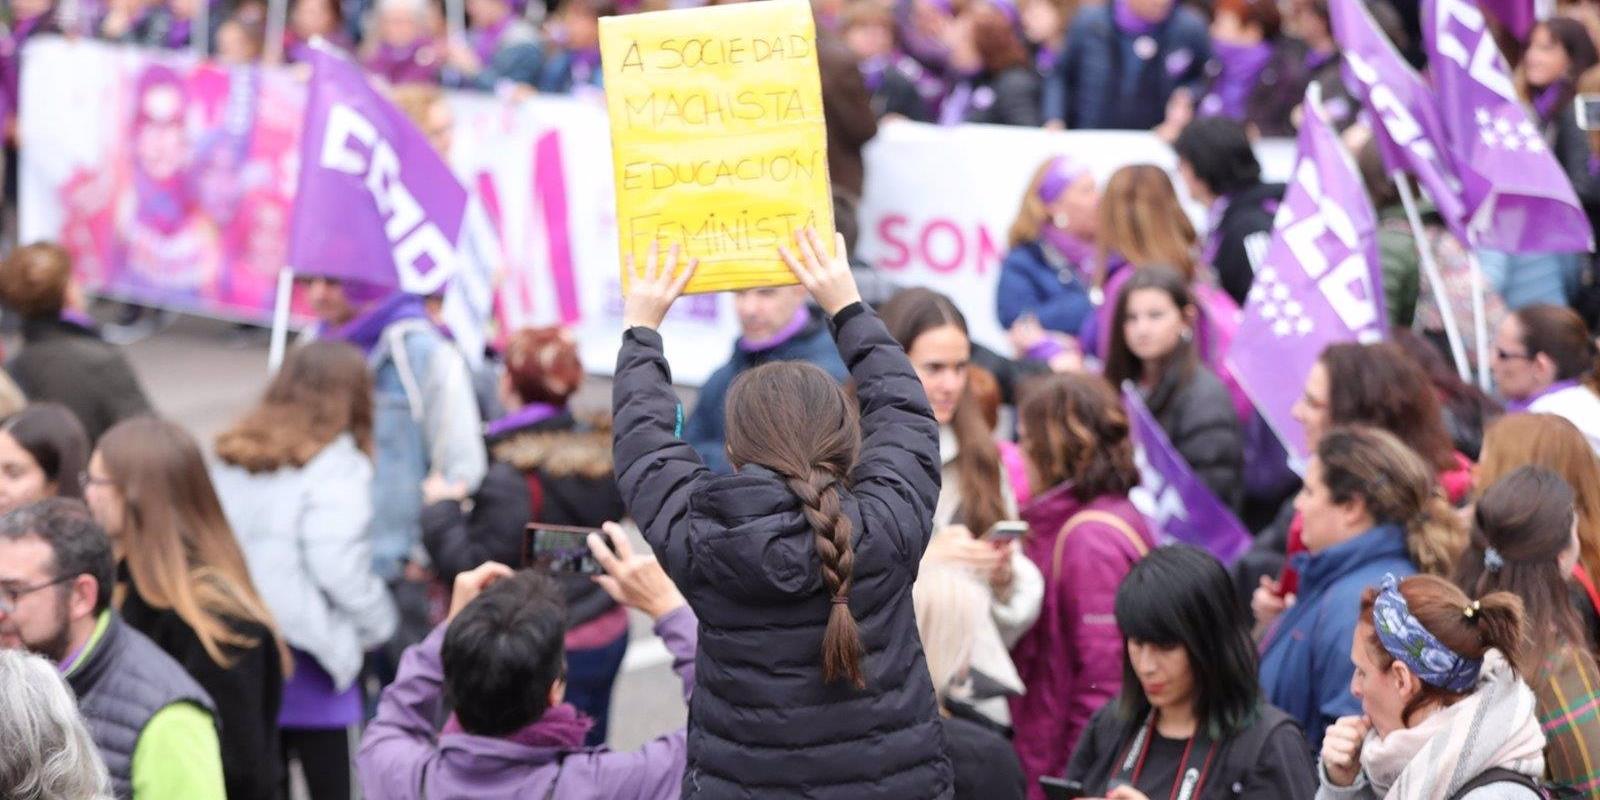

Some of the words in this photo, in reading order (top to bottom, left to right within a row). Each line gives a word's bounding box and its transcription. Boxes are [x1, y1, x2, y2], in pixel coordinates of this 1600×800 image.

[621, 40, 643, 72] A
[656, 35, 810, 69] SOCIEDAD
[624, 89, 806, 129] MACHISTA
[623, 150, 818, 191] EDUCACIÓN
